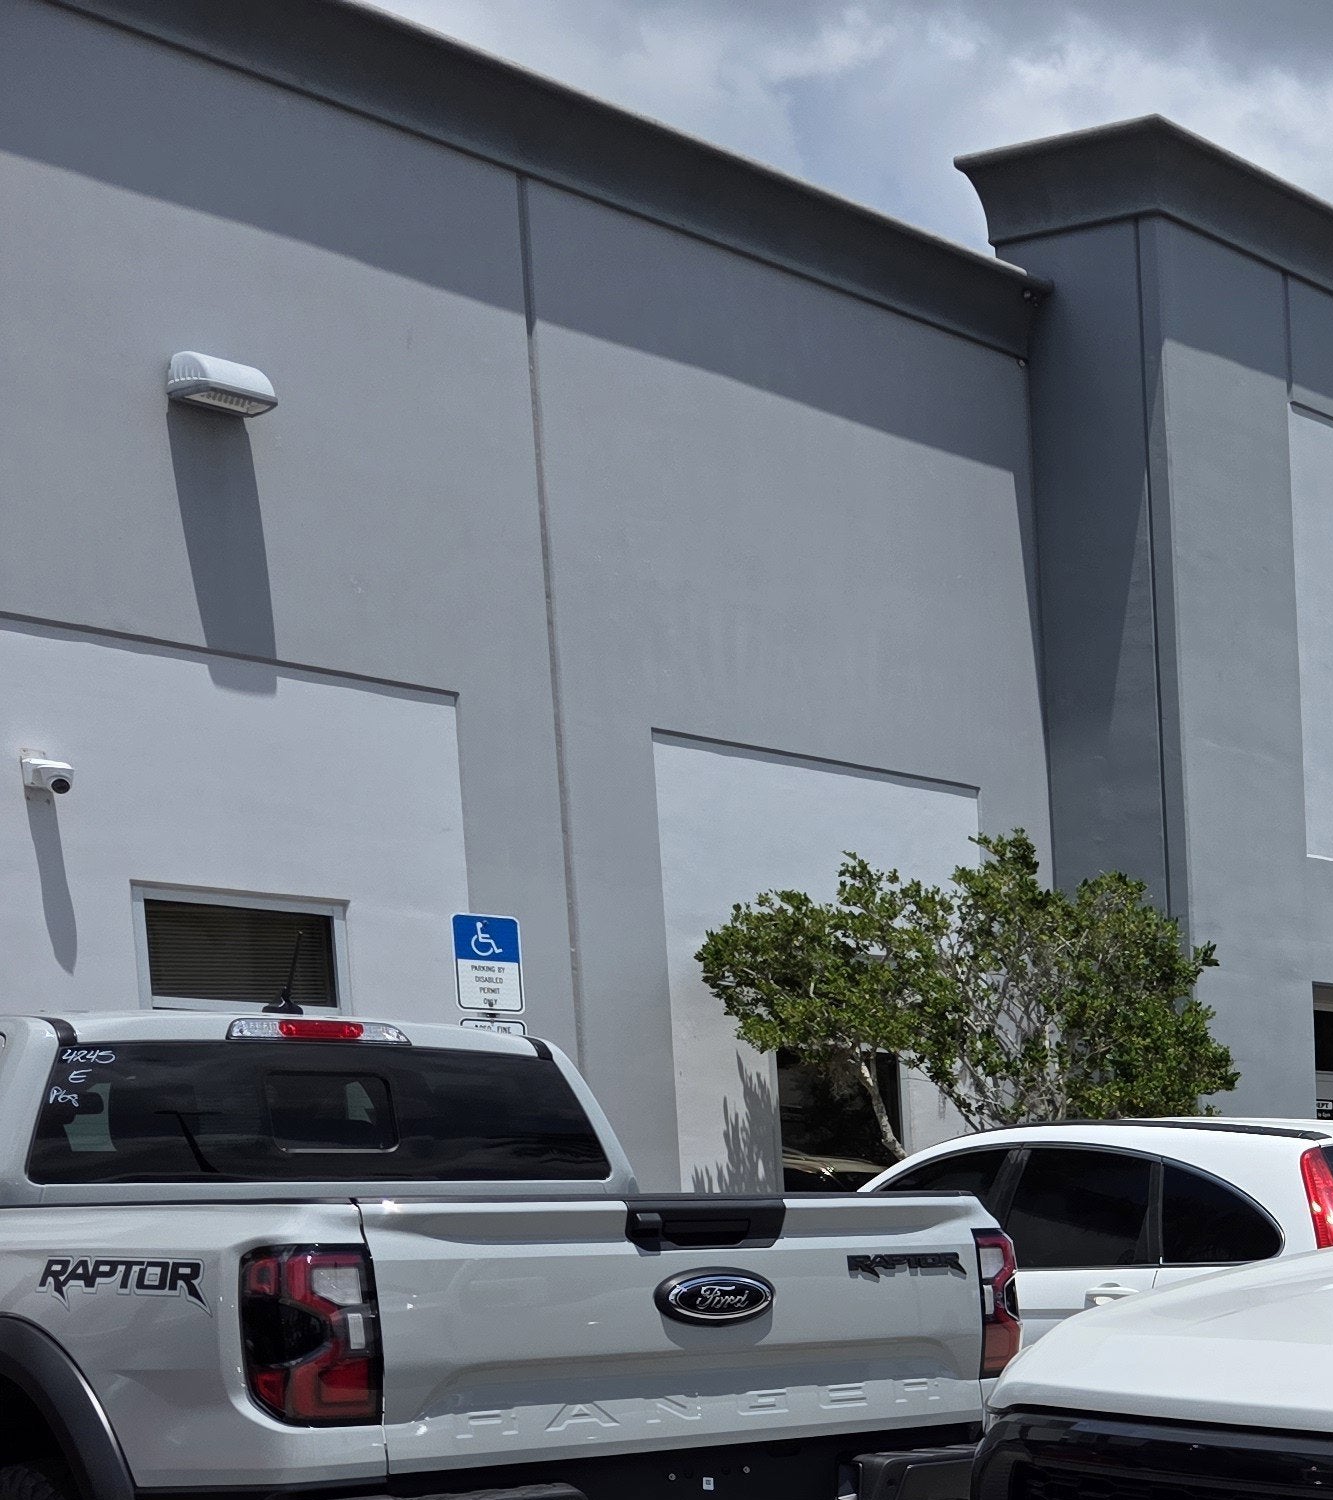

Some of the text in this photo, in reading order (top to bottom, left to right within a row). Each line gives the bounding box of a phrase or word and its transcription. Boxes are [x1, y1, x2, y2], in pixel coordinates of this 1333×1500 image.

[470, 964, 506, 974] PARKING BY
[474, 975, 504, 985] DISABLED
[479, 986, 500, 995] PERMIT
[497, 1025, 512, 1035] FINE
[62, 1049, 116, 1064] 4245
[68, 1068, 93, 1084] E
[846, 1252, 967, 1280] RAPTOR
[38, 1257, 209, 1312] RAPTOR
[696, 1284, 750, 1311] Ford
[453, 1377, 944, 1439] RANGER
